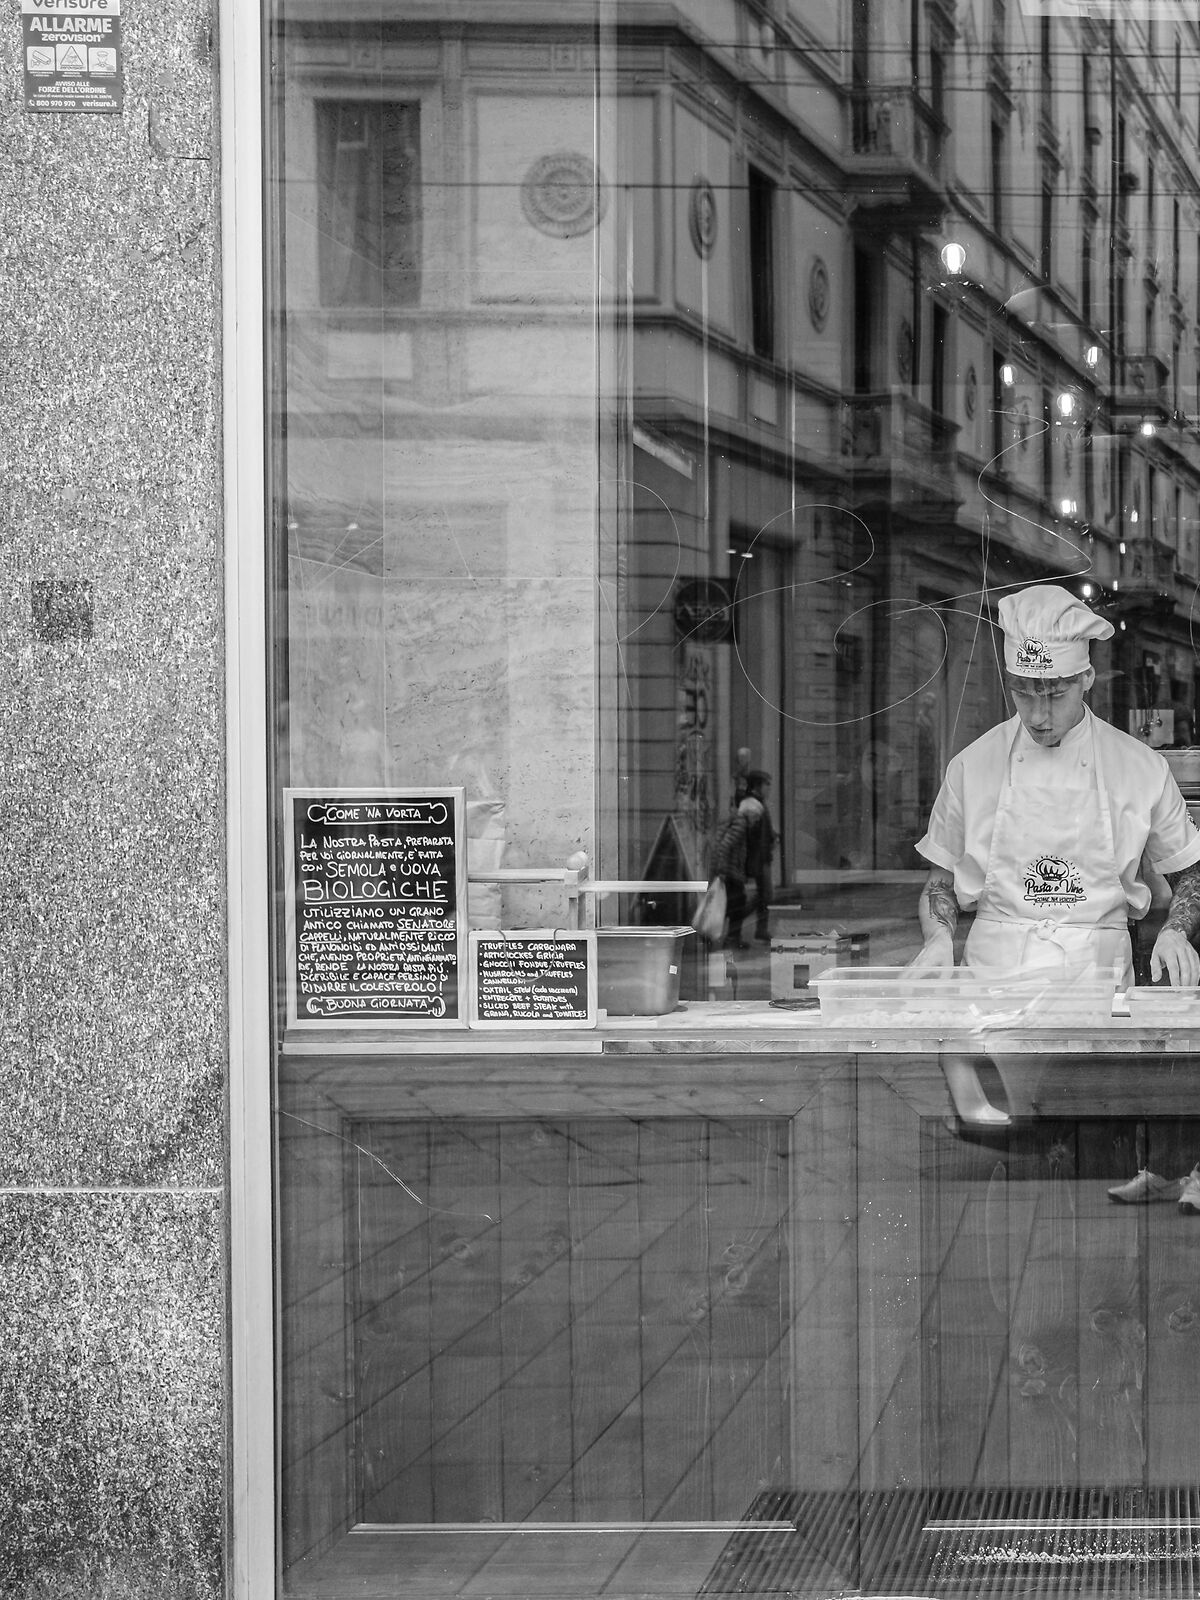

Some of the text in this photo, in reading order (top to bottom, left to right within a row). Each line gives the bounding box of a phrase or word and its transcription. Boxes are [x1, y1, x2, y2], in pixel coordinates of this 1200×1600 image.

[33, 0, 107, 8] verisure
[30, 17, 112, 33] ALLARME
[62, 86, 106, 94] DELL'ORDINE
[326, 807, 360, 821] COME
[386, 808, 421, 819] VORTA
[300, 834, 318, 849] LA
[323, 836, 366, 849] NOSTRA
[406, 836, 454, 847] PREPARATA
[299, 851, 319, 861] PER
[320, 850, 334, 860] VOI
[418, 851, 444, 860] FATTA
[301, 863, 323, 872] CON
[325, 861, 386, 878] SEMOLA
[400, 863, 441, 877] UOVA
[302, 877, 448, 900] BIOLOGICHE
[1025, 878, 1053, 895] Pasta
[1060, 879, 1084, 894] Vino
[303, 905, 444, 918] UTILIZZIAMO UN GRANO
[303, 918, 455, 931] ANTICO CHIAMATO SENATORE
[347, 931, 427, 941] NATURALMENTE
[428, 932, 455, 941] RICCO
[311, 942, 363, 951] FLAVONOIDI
[379, 941, 445, 951] ANTIOSSIDANTI
[527, 943, 577, 951] CARBONARA
[320, 953, 354, 961] AVENDO
[315, 962, 348, 971] RENDE
[368, 963, 400, 971] NOSTRA
[402, 963, 424, 972] PASTA
[300, 971, 349, 981] DIGERIBILE
[361, 972, 396, 981] CAPACE
[397, 972, 437, 981] PERSINO
[301, 981, 348, 994] RIDURRE
[349, 982, 360, 992] IL
[325, 998, 428, 1011] BUONA GIORNATA
[513, 1010, 540, 1018] RUCOLA
